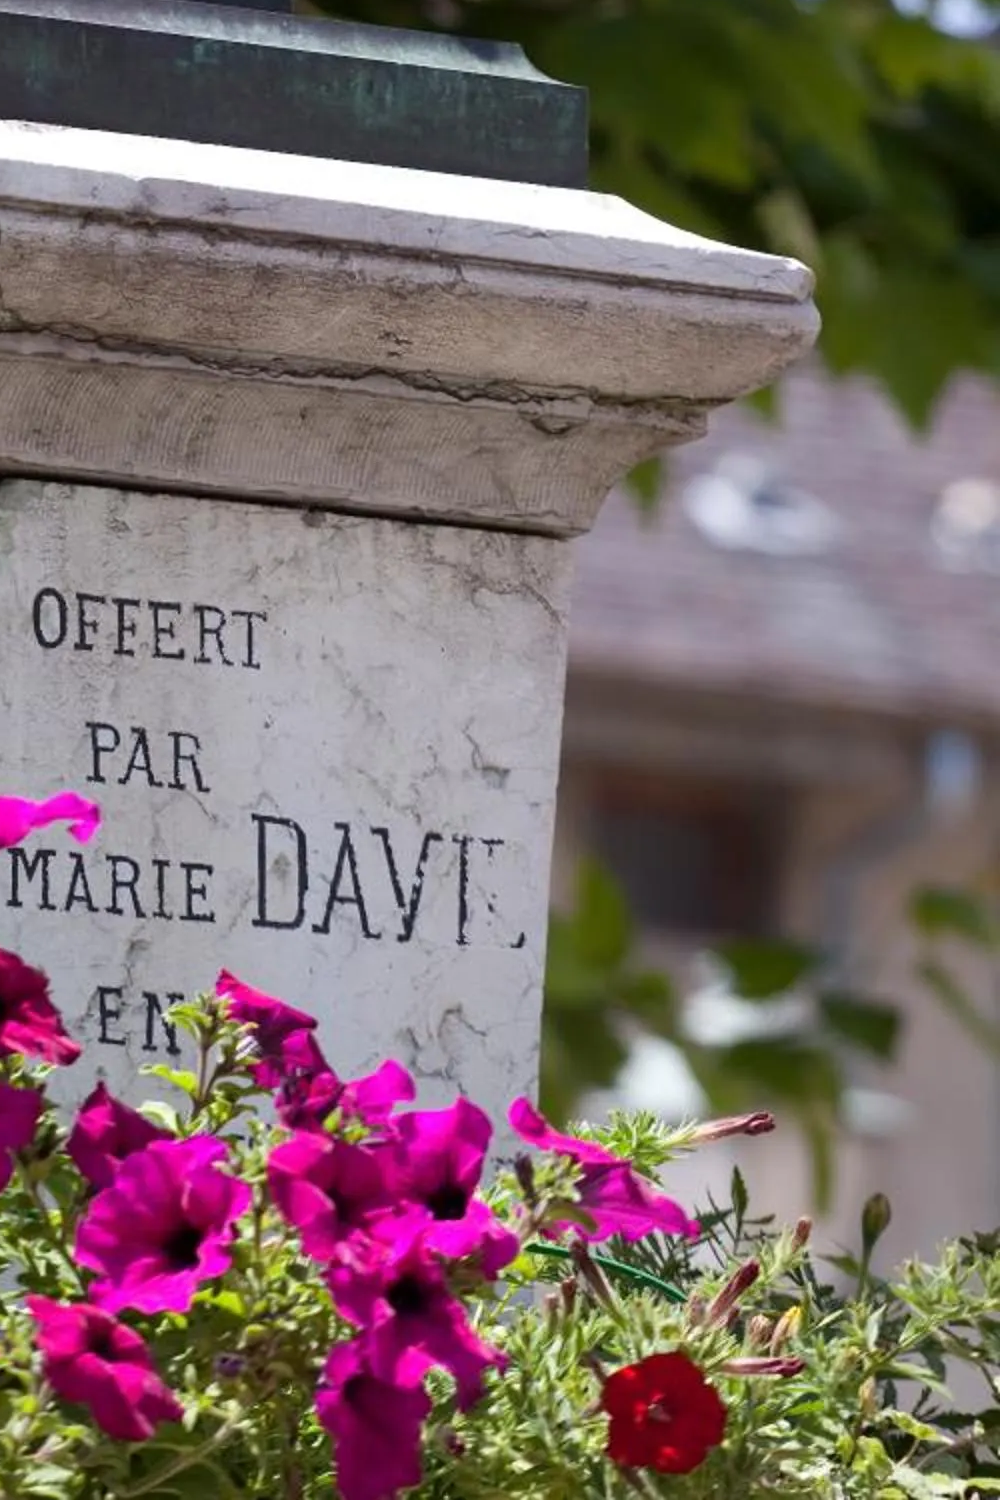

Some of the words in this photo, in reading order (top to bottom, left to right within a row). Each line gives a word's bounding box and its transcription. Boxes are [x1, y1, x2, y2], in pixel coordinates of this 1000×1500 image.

[33, 587, 268, 670] OFFERT
[85, 721, 210, 793] PAR
[7, 846, 216, 923] MARIE
[97, 986, 184, 1055] EN
